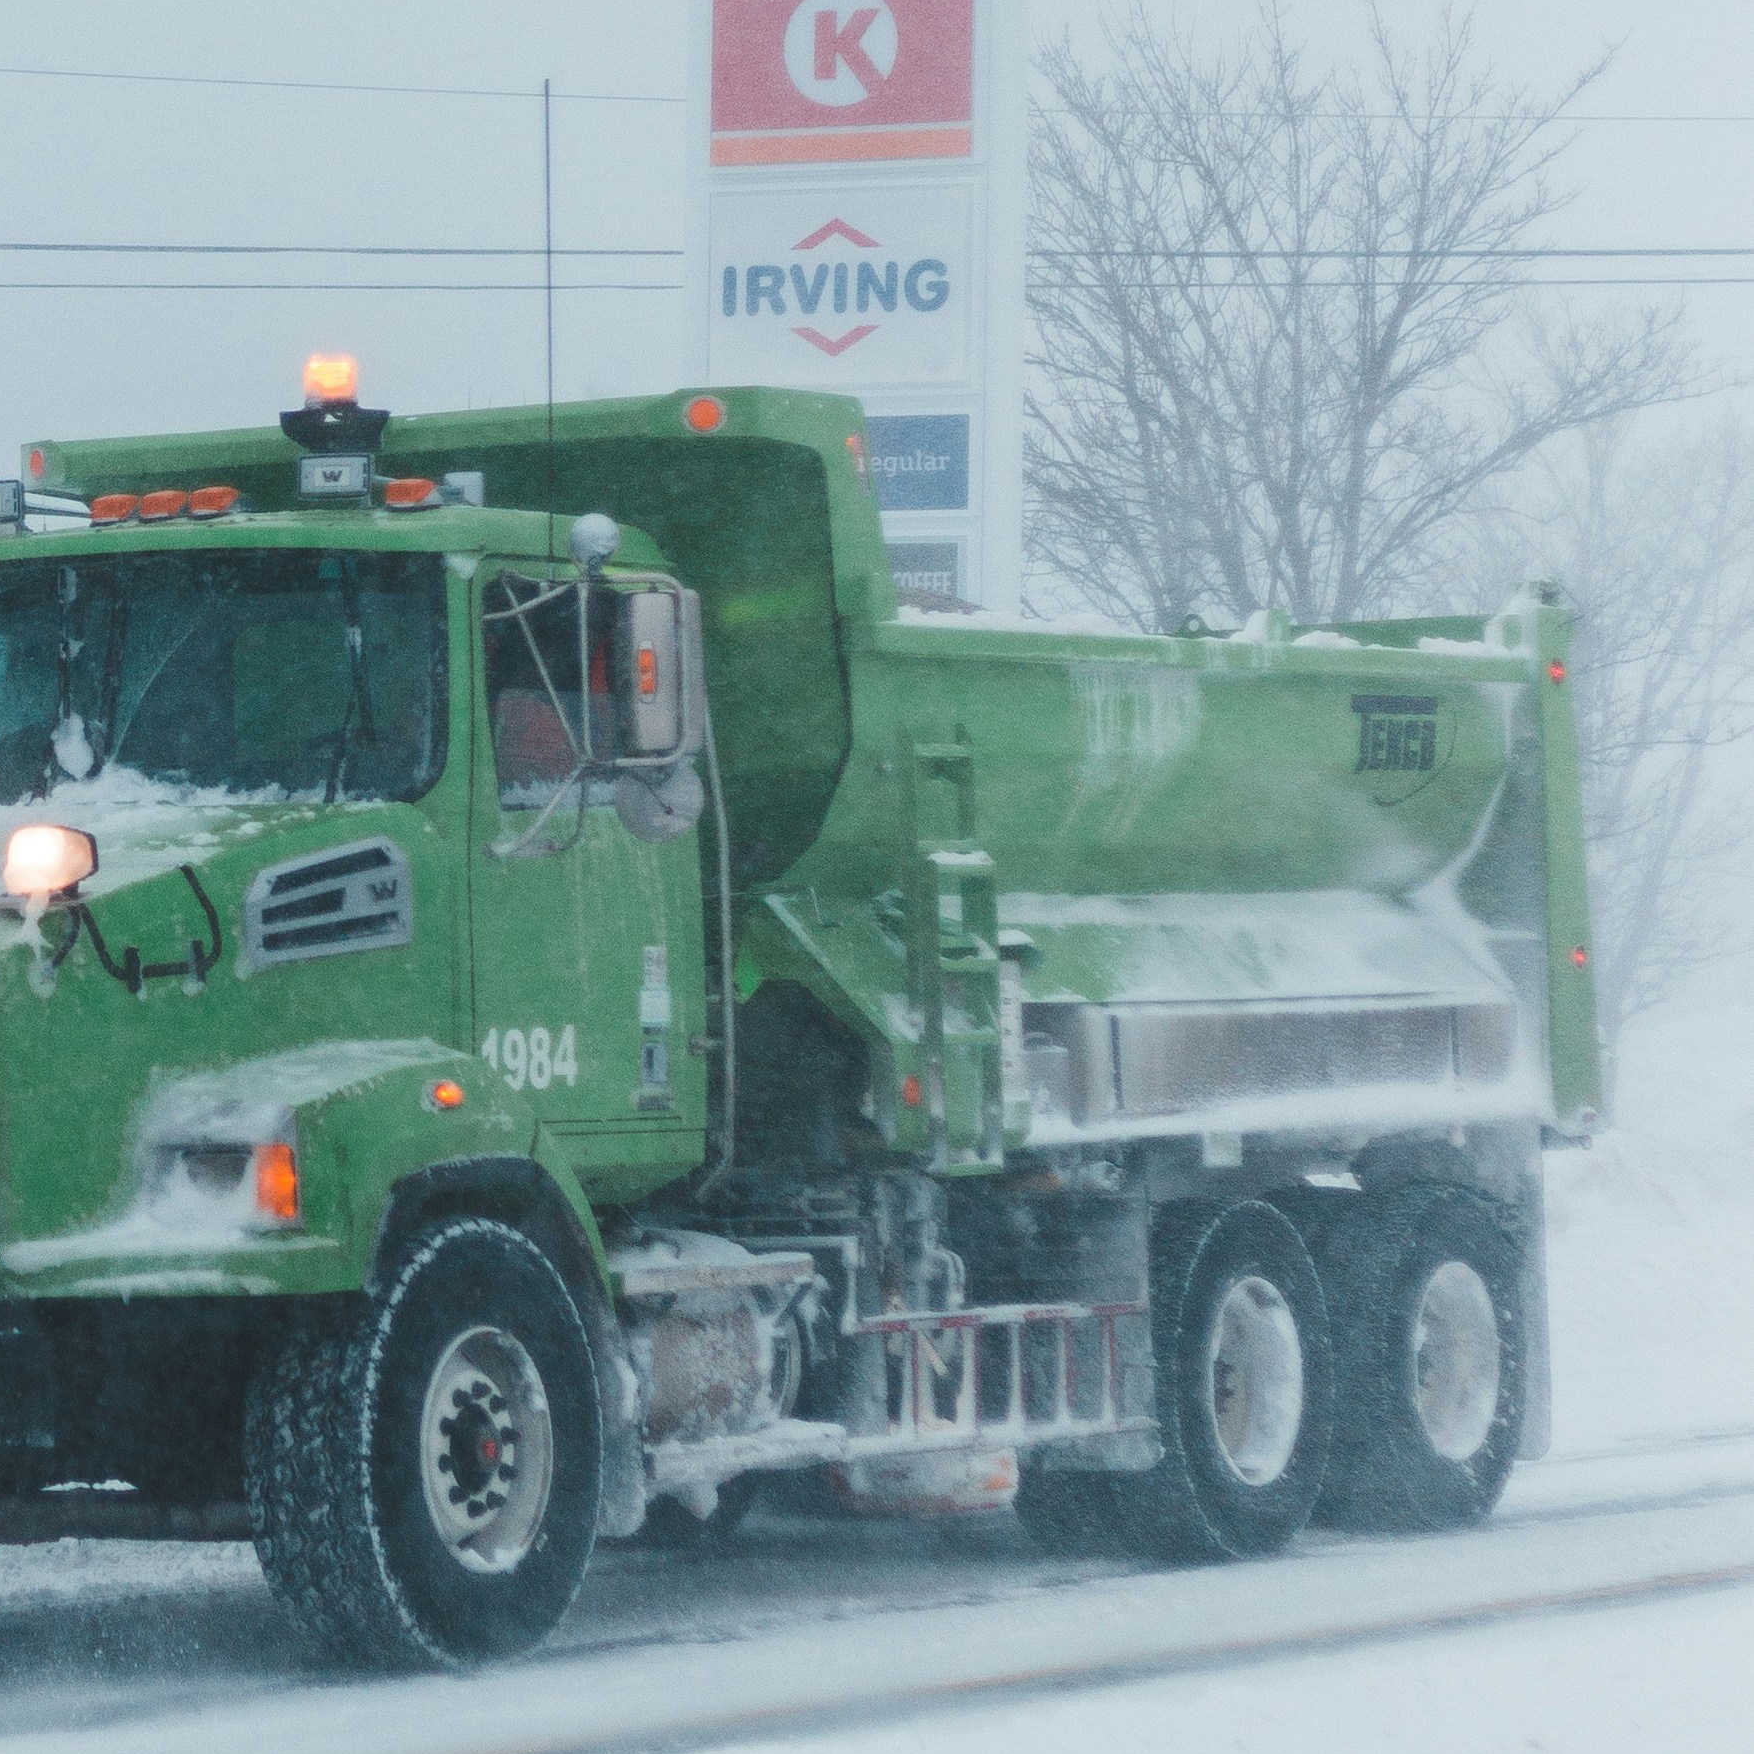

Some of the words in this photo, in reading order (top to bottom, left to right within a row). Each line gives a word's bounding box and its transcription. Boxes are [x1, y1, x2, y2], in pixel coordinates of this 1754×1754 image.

[812, 7, 890, 98] K
[721, 257, 950, 318] IRVING
[482, 1024, 578, 1090] 1984
